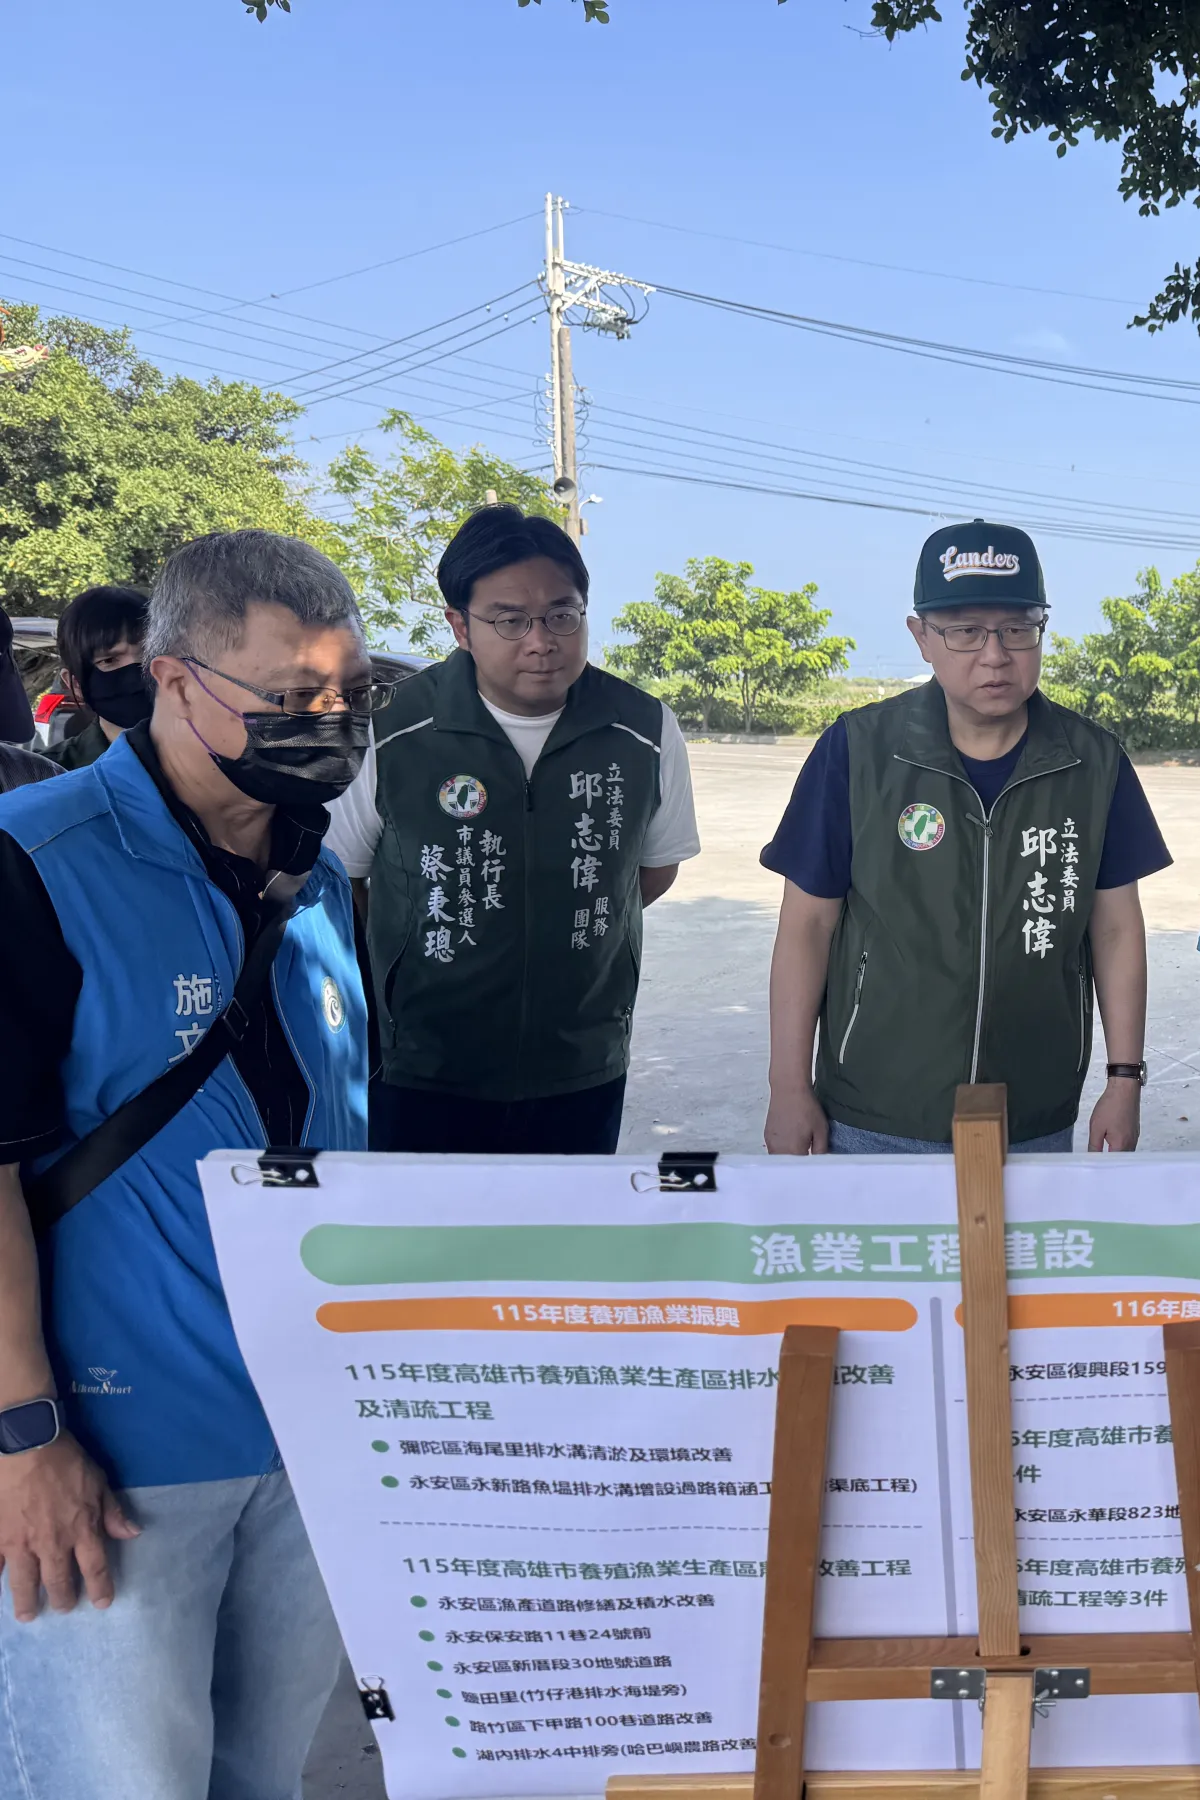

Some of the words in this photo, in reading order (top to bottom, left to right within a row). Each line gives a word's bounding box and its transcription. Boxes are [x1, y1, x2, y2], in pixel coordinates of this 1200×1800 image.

[939, 545, 1020, 581] Landers
[569, 771, 603, 893] 邱志偉
[606, 762, 625, 850] 立法委員
[455, 824, 478, 947] 市議員參選人
[479, 829, 507, 911] 執行長
[1020, 826, 1057, 959] 邱志偉
[1060, 817, 1081, 914] 立法委員
[571, 908, 590, 950] 團隊
[592, 897, 610, 937] 服務
[168, 973, 213, 1064] 施文
[492, 1304, 741, 1328] 115年度養殖漁業振興
[355, 1399, 495, 1421] 及清疏工程
[445, 1626, 652, 1644] 永安保安路11巷24號前
[469, 1710, 713, 1734] 路竹區下甲路100巷道路改善
